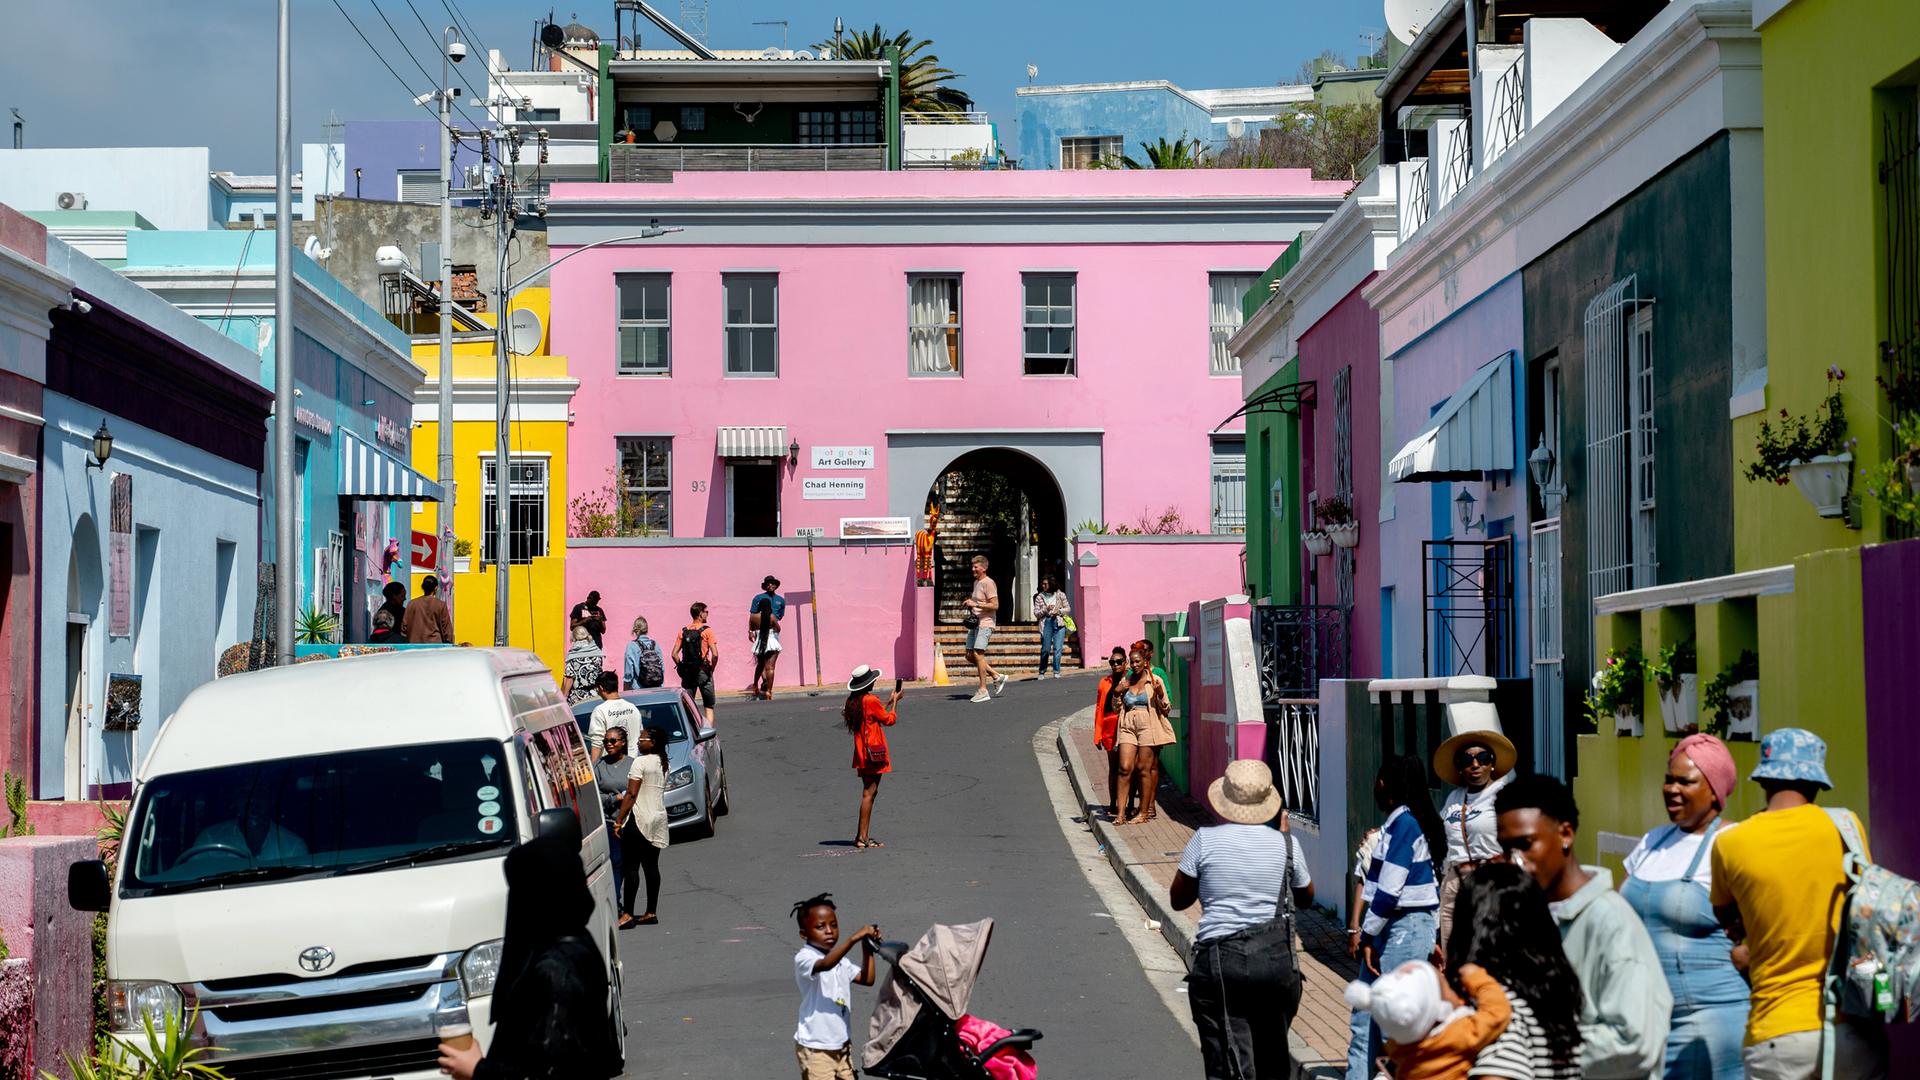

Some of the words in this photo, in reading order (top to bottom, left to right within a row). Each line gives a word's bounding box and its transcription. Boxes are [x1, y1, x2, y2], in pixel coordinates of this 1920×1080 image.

[834, 458, 866, 467] Gallery
[692, 480, 706, 492] 93
[829, 481, 864, 490] Henning
[608, 708, 634, 718] baguette
